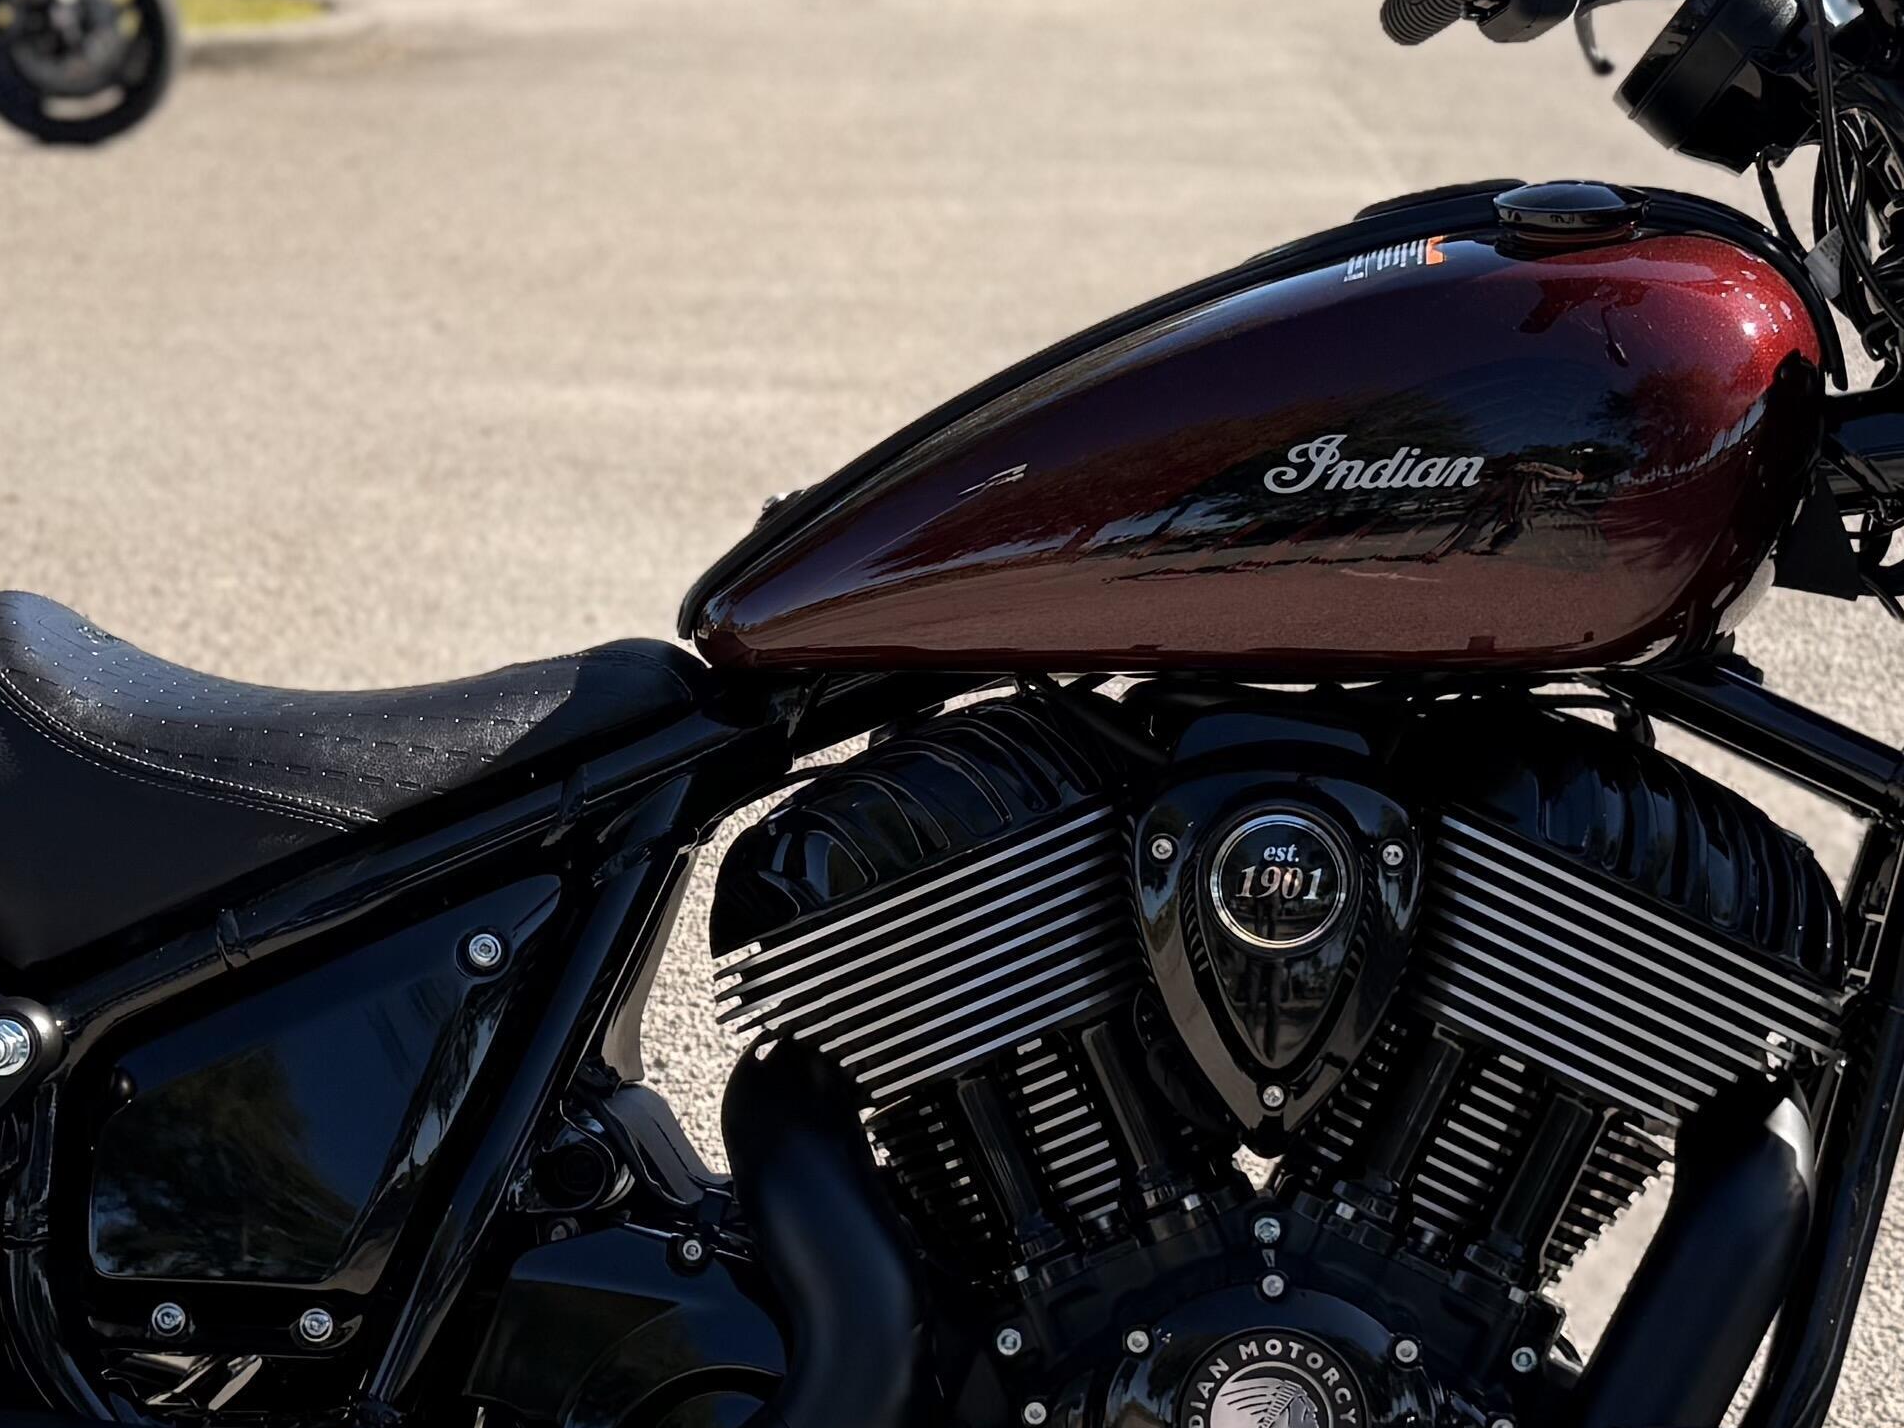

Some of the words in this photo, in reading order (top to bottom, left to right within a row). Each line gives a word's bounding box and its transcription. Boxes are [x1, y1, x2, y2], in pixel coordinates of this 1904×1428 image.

[1264, 434, 1485, 495] Indian
[1262, 843, 1300, 863] est.
[1234, 864, 1324, 901] 1901
